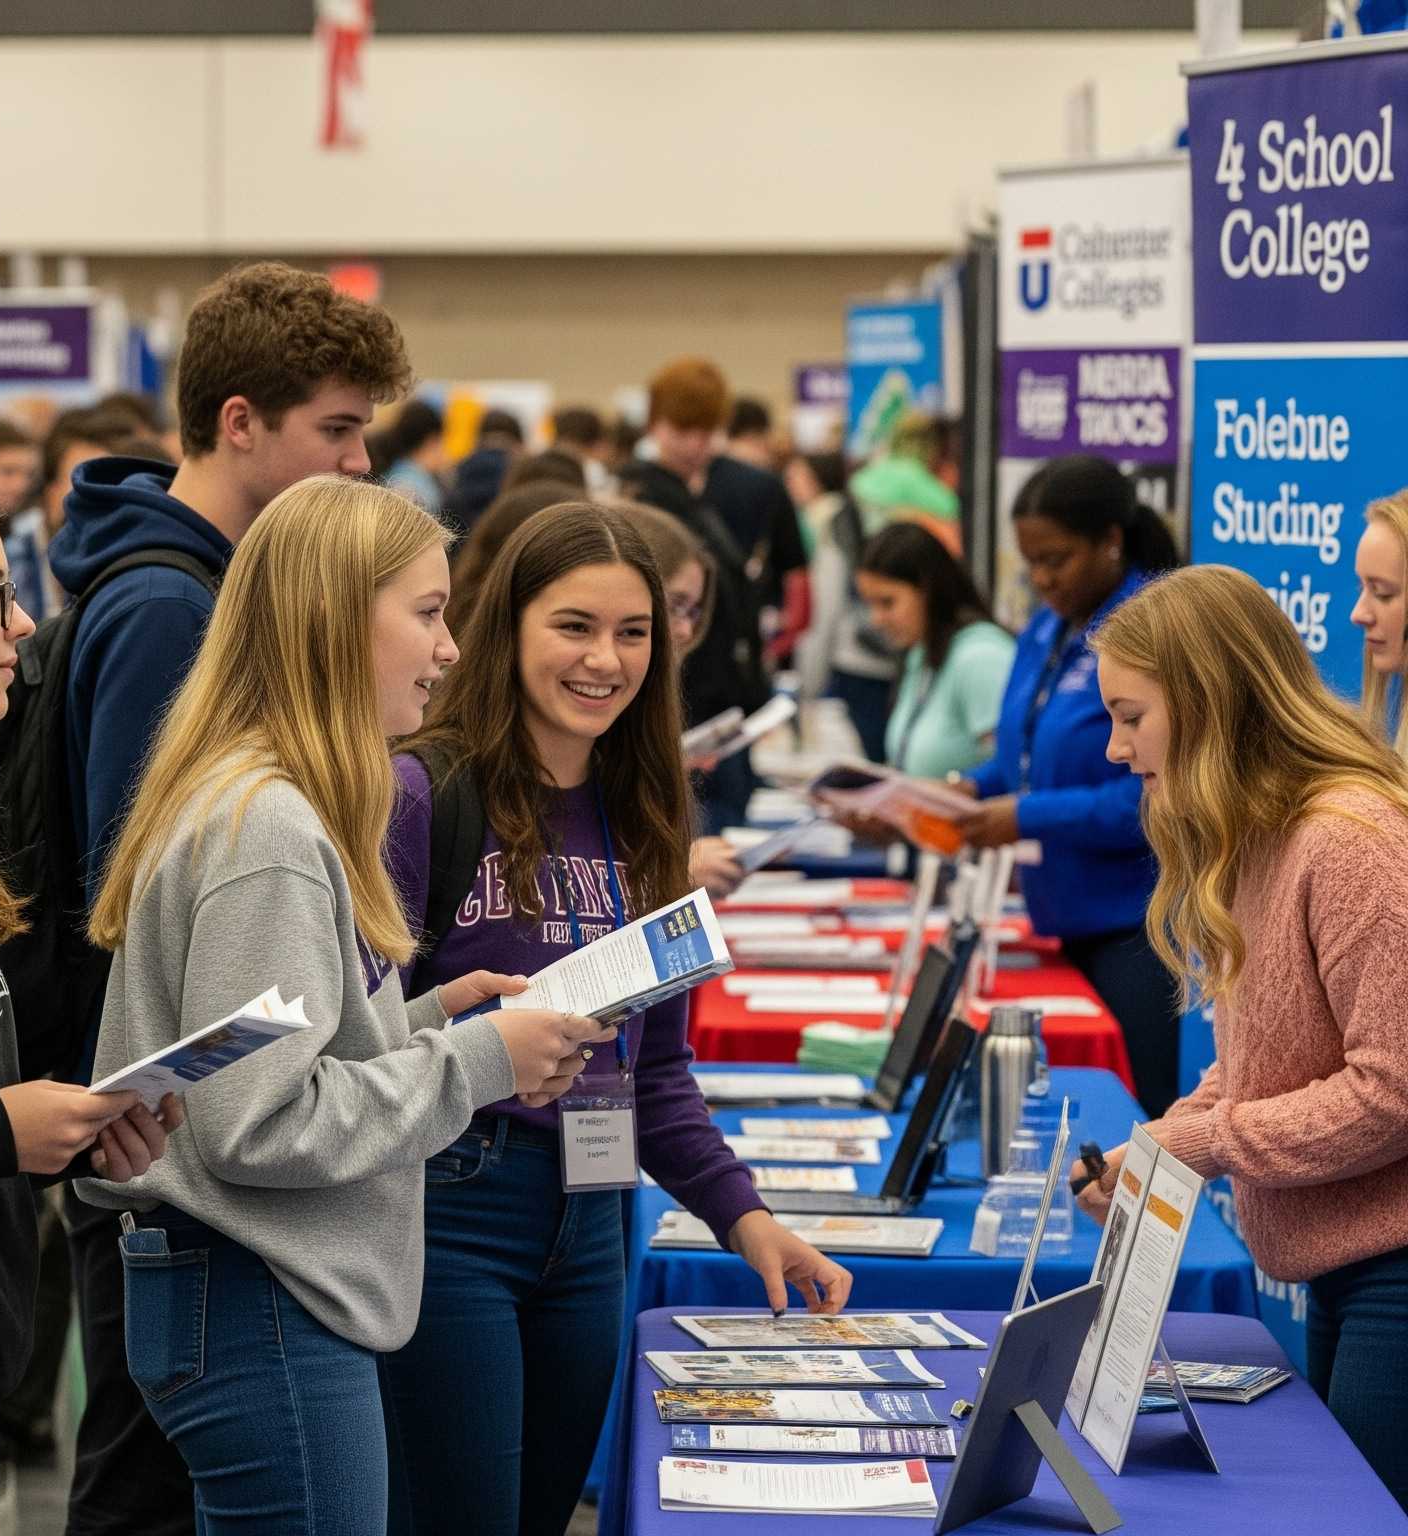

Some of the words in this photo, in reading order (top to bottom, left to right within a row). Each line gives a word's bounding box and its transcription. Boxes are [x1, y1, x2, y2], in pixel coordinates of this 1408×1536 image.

[1258, 103, 1394, 194] School
[1220, 202, 1370, 294] College
[1212, 481, 1344, 565] Studing
